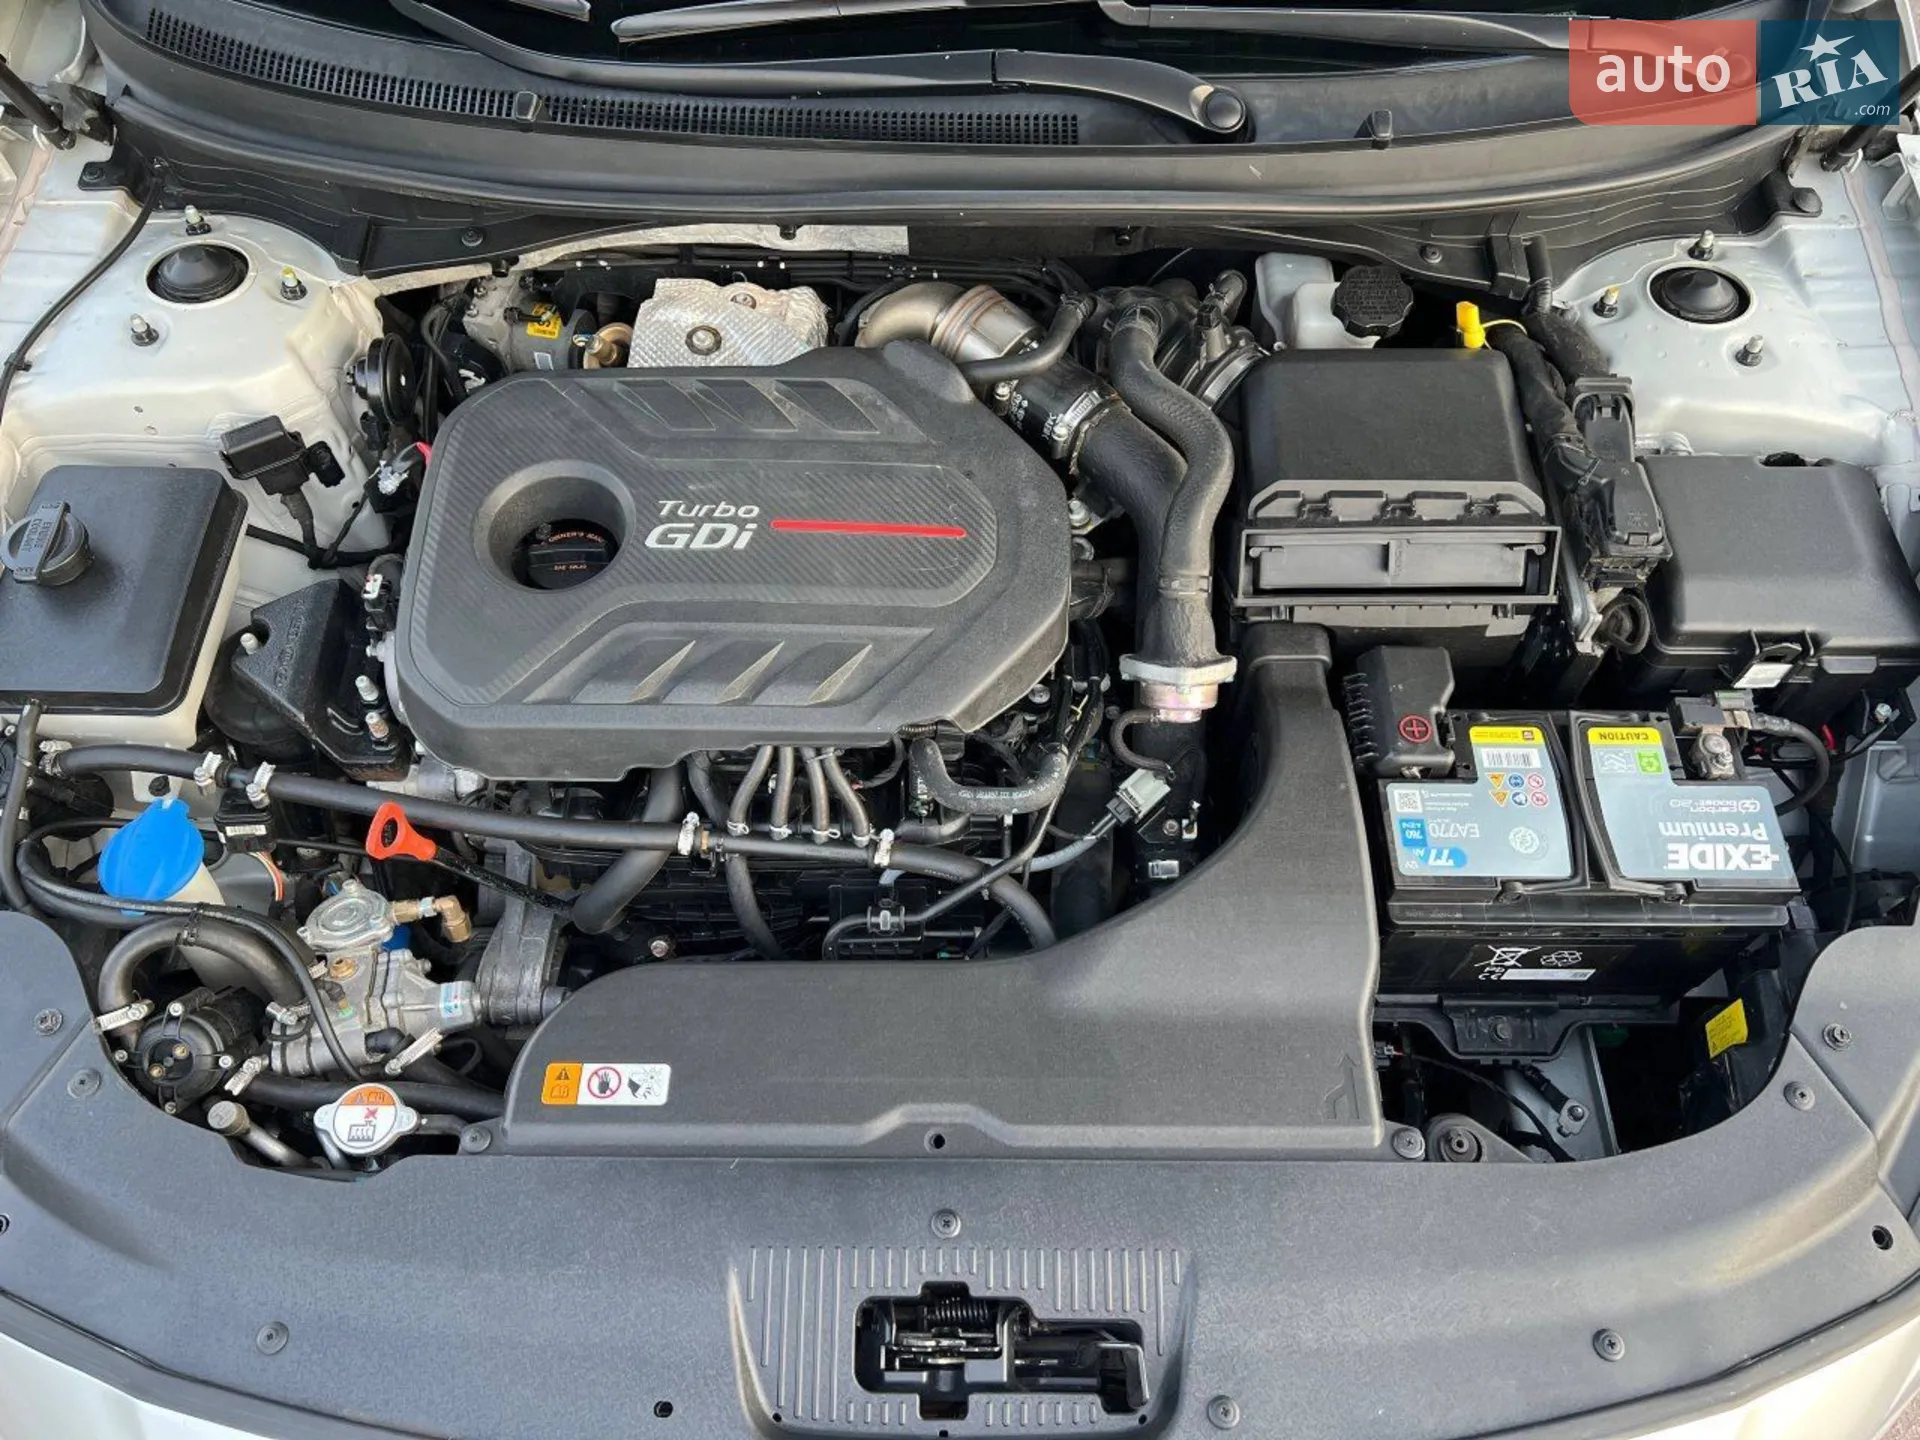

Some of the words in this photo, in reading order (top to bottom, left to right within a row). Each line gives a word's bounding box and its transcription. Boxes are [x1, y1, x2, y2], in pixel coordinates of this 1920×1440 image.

[658, 500, 760, 518] Turbo
[644, 523, 758, 549] GDi
[1598, 731, 1650, 741] CAUTION
[1428, 823, 1480, 838] EA770
[1658, 820, 1770, 841] Premium
[1428, 848, 1455, 866] 77
[1666, 842, 1780, 871] EXIDE
